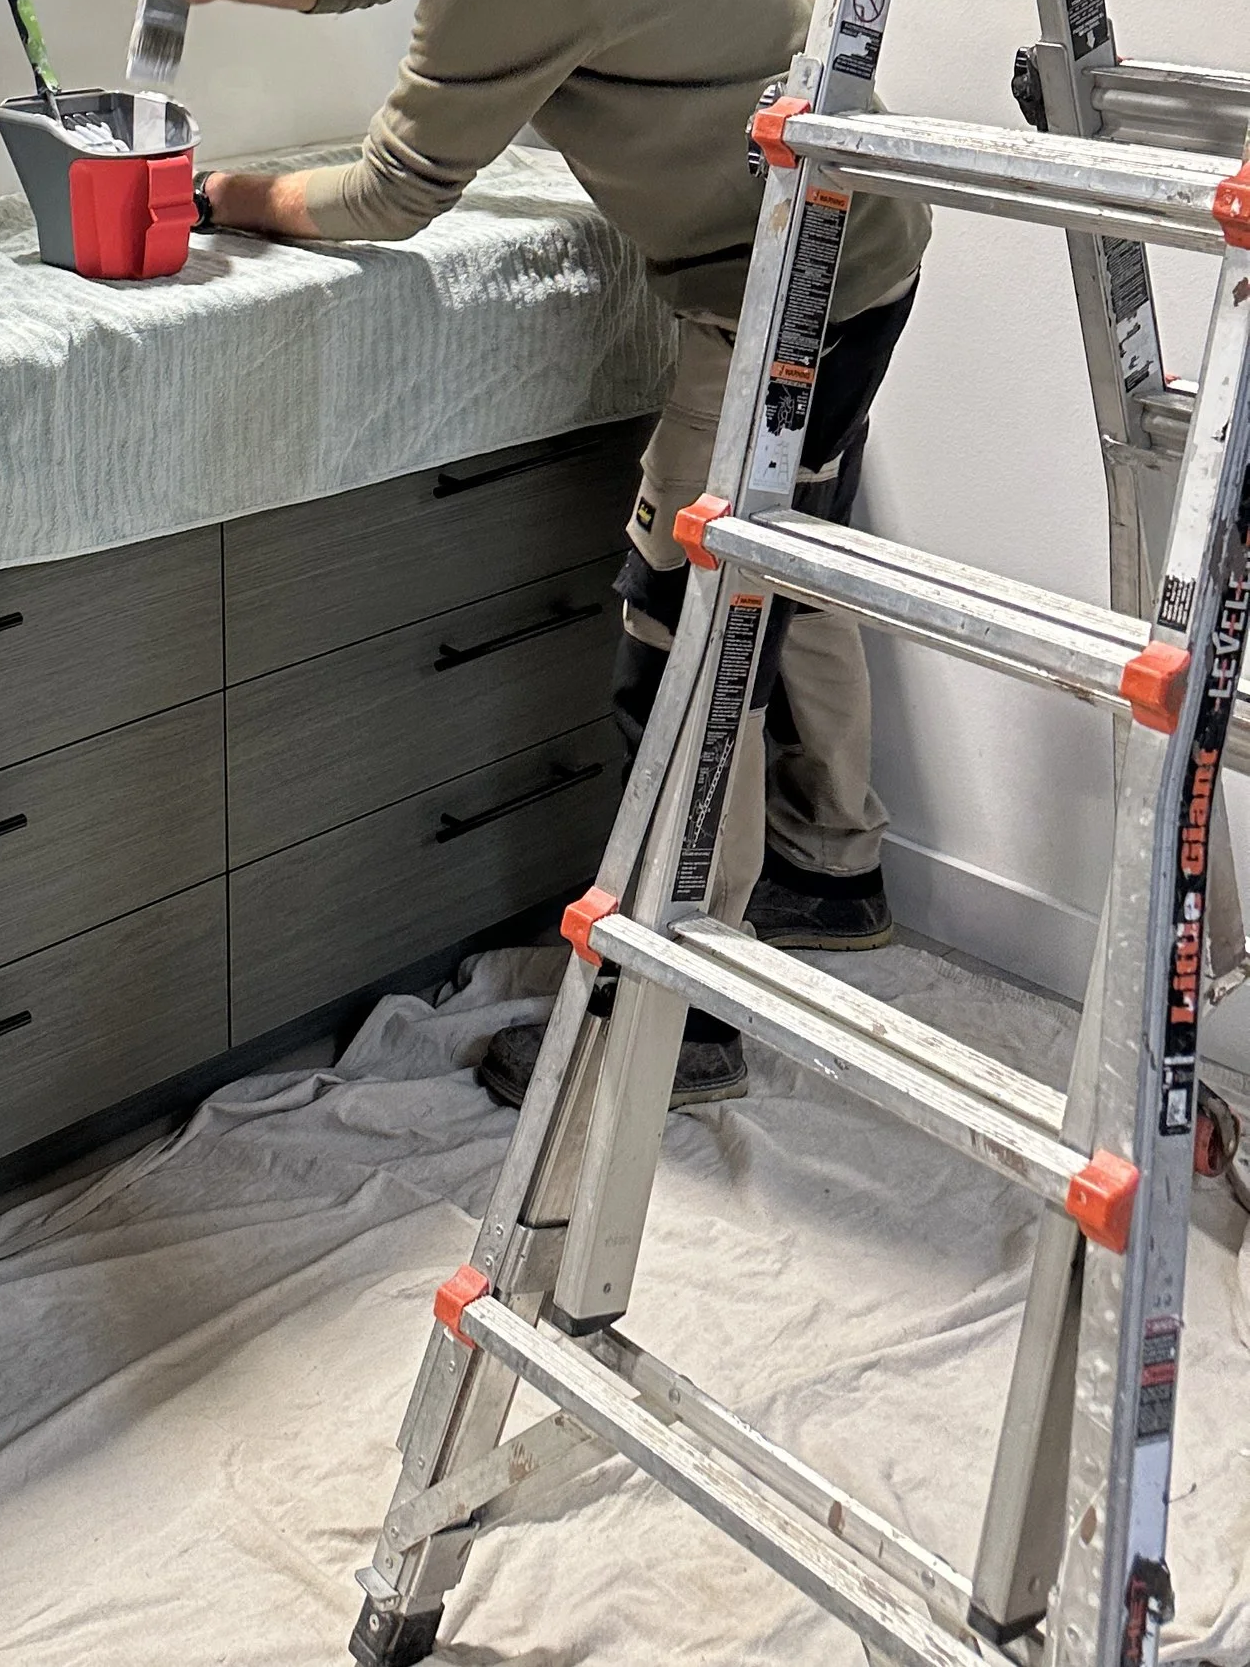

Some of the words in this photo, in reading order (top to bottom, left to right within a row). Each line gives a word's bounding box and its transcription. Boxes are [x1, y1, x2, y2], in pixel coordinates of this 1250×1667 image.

[1208, 549, 1250, 706] LEVELE
[1180, 747, 1218, 876] Giant
[1170, 892, 1202, 1024] Little
